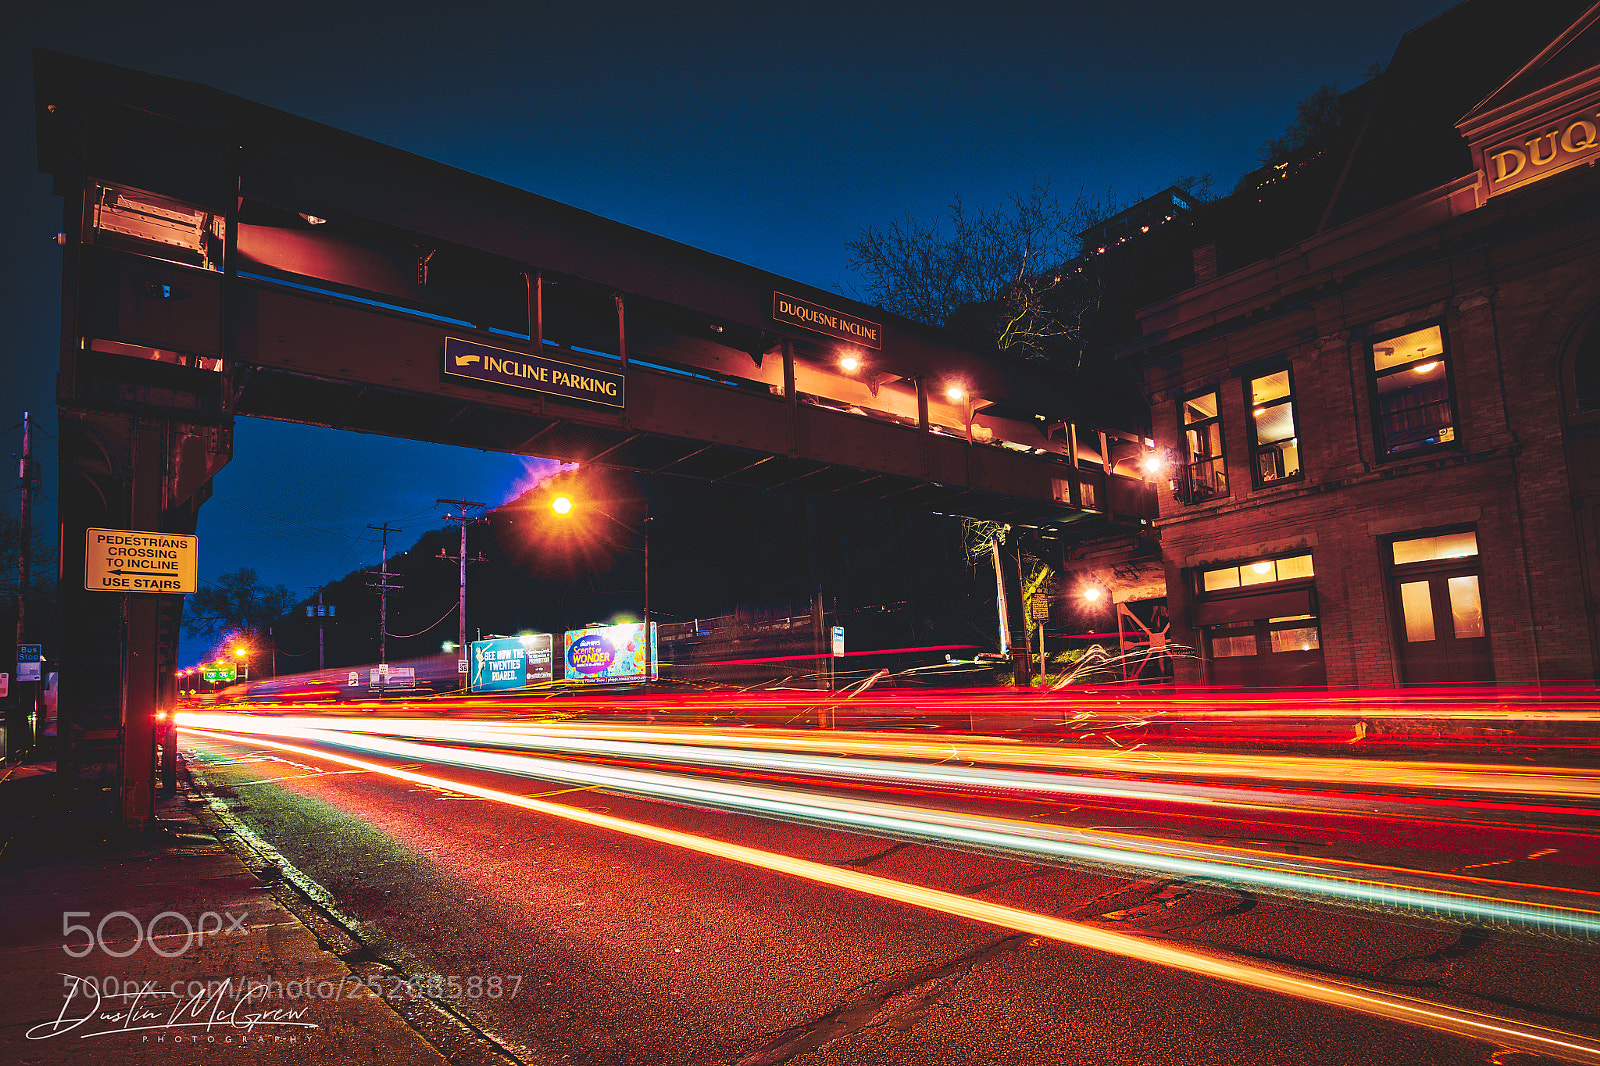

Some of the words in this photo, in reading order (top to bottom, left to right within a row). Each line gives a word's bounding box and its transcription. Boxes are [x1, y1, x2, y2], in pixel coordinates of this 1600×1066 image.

[1491, 112, 1600, 183] DUQ
[779, 300, 838, 329] DUQUESNE
[839, 319, 877, 341] INCLINE
[484, 355, 549, 382] INCLINE
[552, 369, 617, 396] PARKING
[97, 534, 188, 549] PEDESTRIANS
[108, 546, 177, 559] CROSSING
[106, 558, 124, 567] TO
[127, 559, 179, 570] INCLINE
[102, 577, 130, 587] USE
[133, 579, 181, 589] STAIRS
[484, 651, 496, 661] SEE
[496, 649, 512, 660] HOW
[512, 648, 525, 659] THE
[573, 645, 595, 654] Scents
[18, 653, 39, 661] Stop
[573, 652, 610, 664] WONDER
[488, 659, 521, 671] TWENTIES
[491, 670, 518, 682] ROARED.
